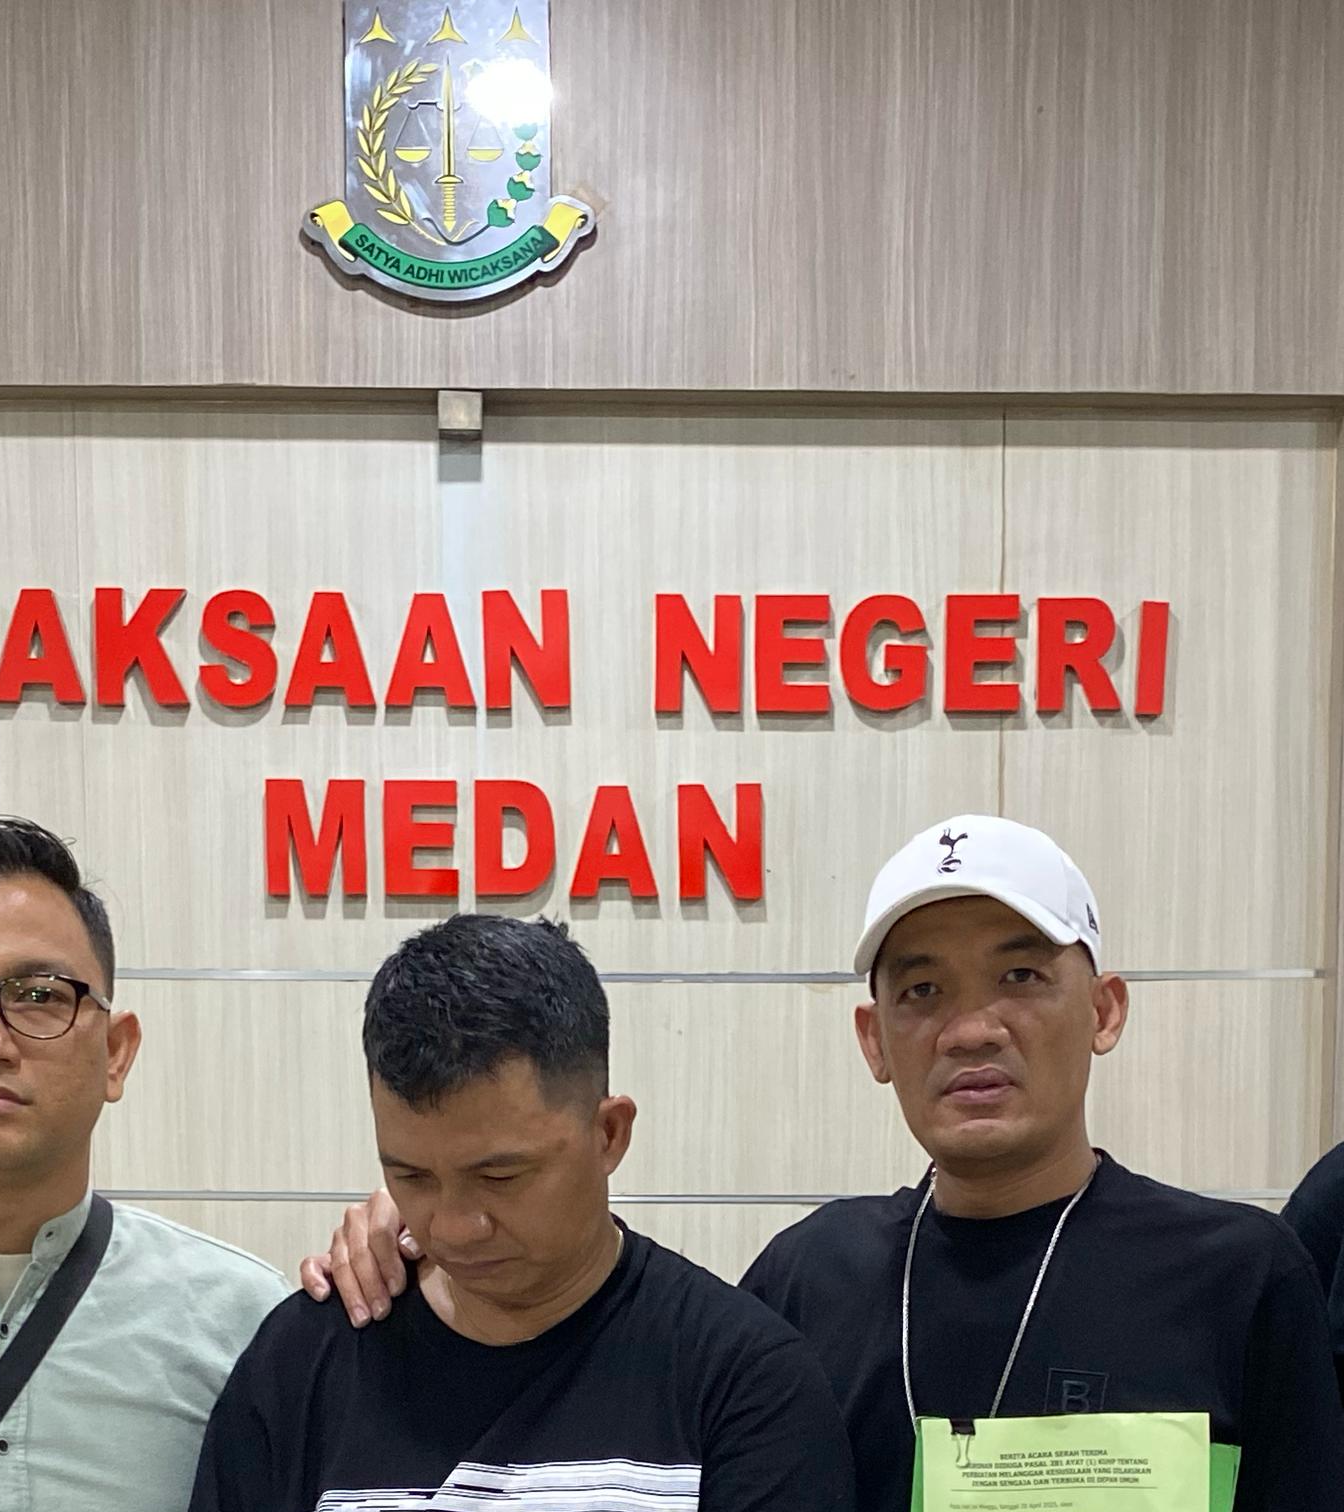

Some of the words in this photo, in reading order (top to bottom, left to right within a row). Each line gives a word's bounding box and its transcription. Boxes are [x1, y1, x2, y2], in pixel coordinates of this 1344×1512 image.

[354, 233, 402, 274] SATYA
[404, 262, 445, 284] ADHI
[447, 233, 545, 285] WICAKSANA
[654, 592, 1171, 715] NEGERI
[264, 778, 765, 901] MEDAN
